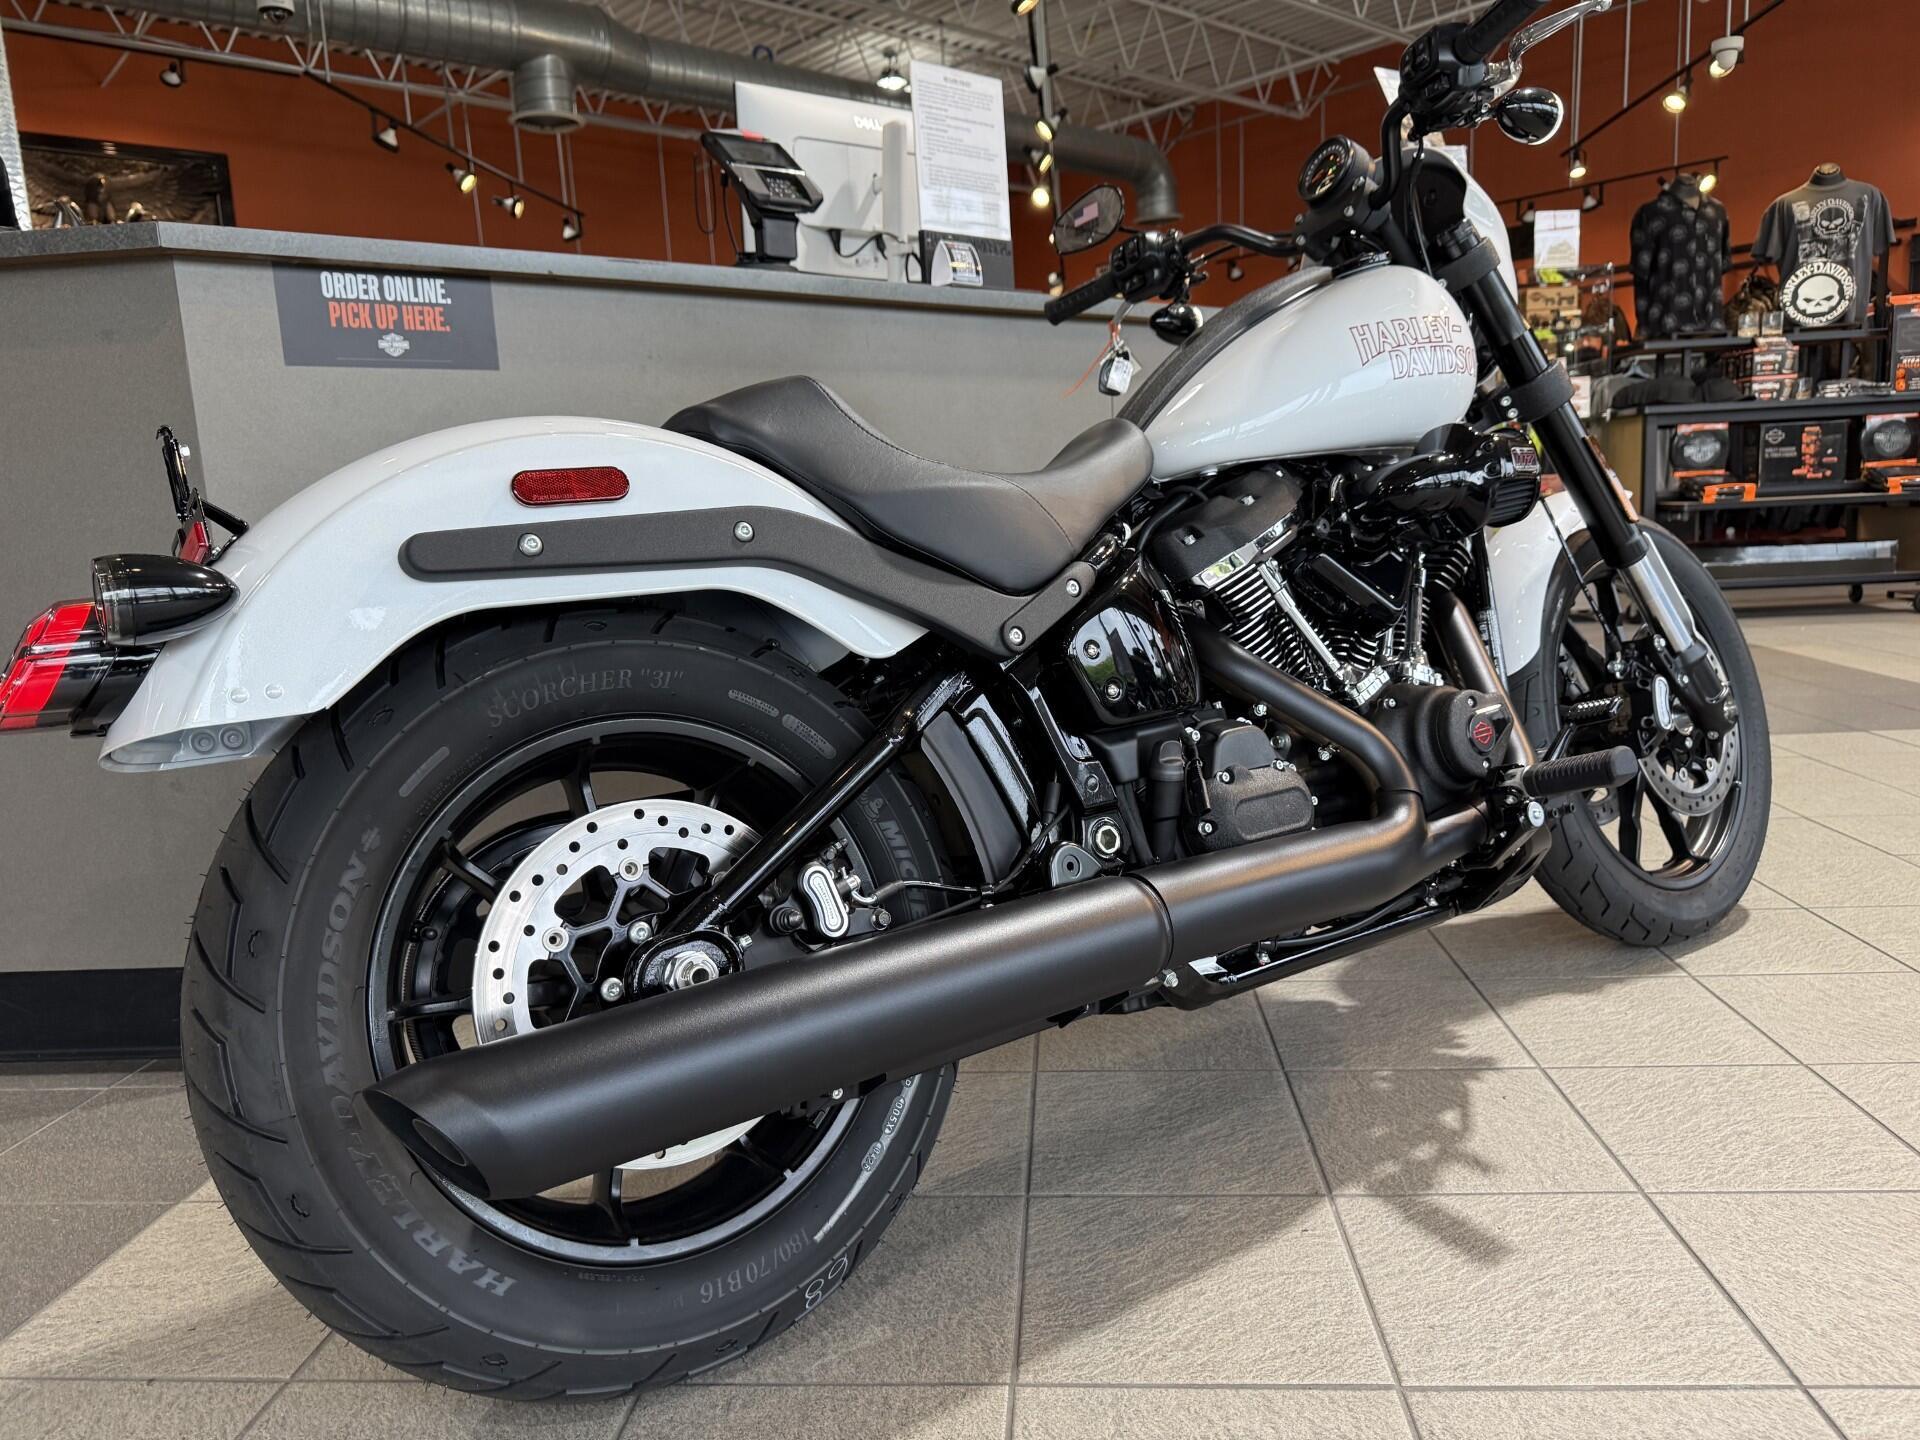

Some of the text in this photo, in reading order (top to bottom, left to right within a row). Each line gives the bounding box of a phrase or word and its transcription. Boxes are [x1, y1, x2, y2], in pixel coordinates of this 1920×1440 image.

[319, 271, 452, 304] ORDER ONLINE.
[328, 301, 452, 332] PICK UP HERE.
[1349, 315, 1462, 367] HARLEY-
[1389, 344, 1476, 381] DAVIDSO
[487, 668, 686, 729] SCORCHER "31"
